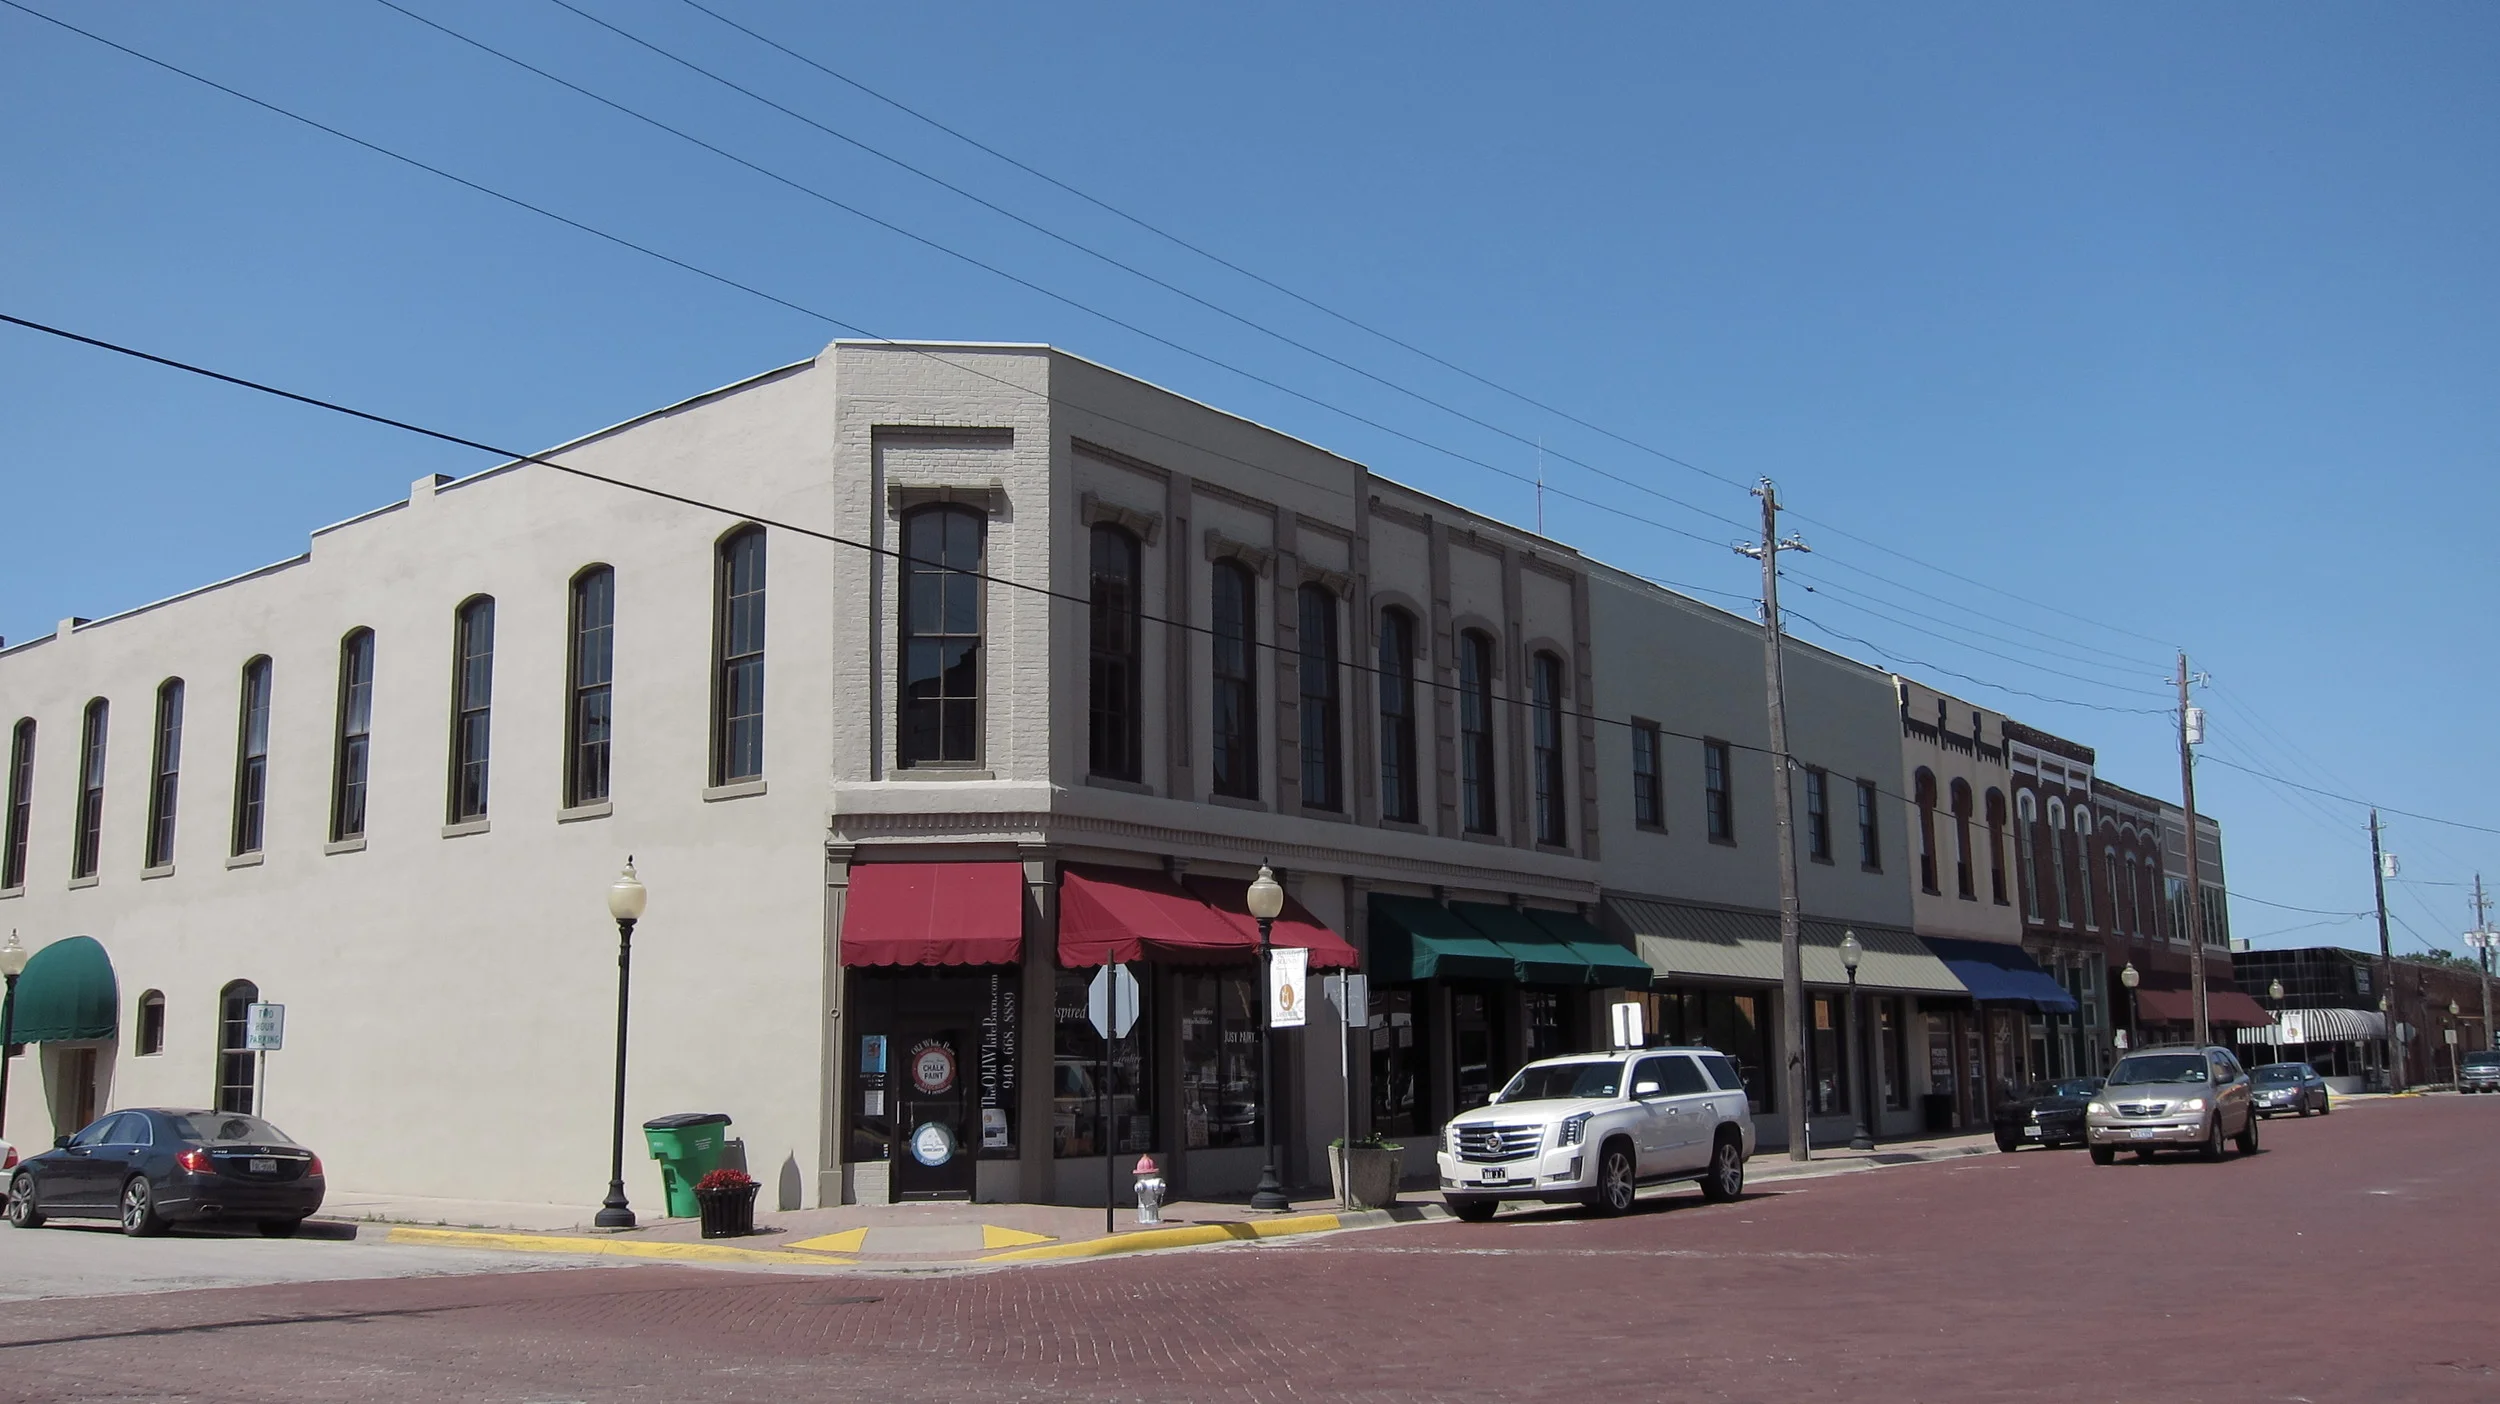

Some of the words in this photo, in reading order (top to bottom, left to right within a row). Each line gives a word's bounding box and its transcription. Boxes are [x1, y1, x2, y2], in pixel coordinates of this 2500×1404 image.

[1054, 1003, 1089, 1023] spired
[249, 1034, 280, 1044] PARKING
[922, 1064, 945, 1072] CHALK
[924, 1072, 943, 1080] PAINT
